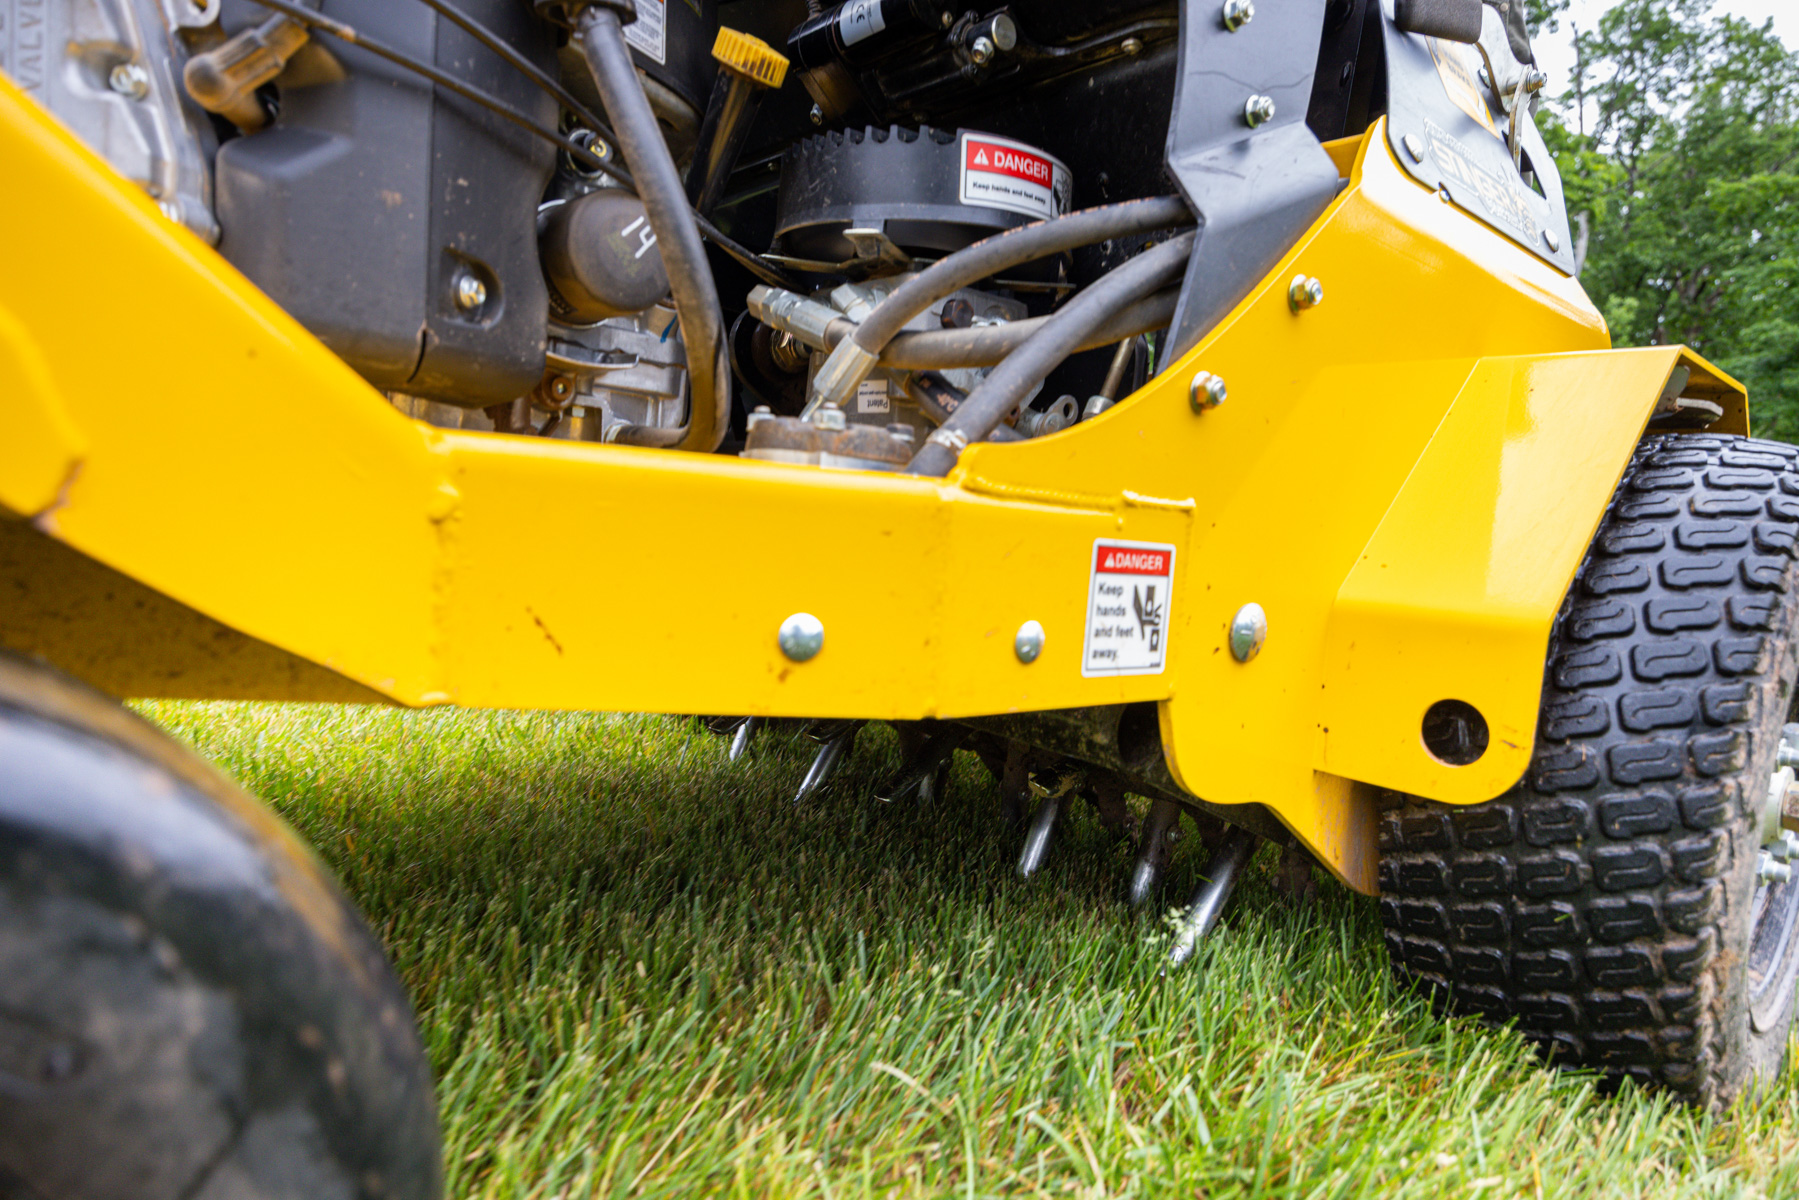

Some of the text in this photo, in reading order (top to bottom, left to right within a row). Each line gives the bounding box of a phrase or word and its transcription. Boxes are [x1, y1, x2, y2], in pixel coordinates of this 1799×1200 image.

[20, 0, 42, 91] VALV
[994, 150, 1049, 181] DANGER
[973, 181, 990, 192] Keep
[992, 184, 1011, 194] hands
[1012, 189, 1023, 197] and
[1023, 191, 1034, 199] feet
[621, 215, 657, 259] 14
[867, 398, 889, 409] Patent
[1115, 552, 1164, 571] DANGER
[1099, 582, 1124, 598] Keep
[1096, 604, 1126, 617] hands
[1094, 625, 1134, 638] and feet
